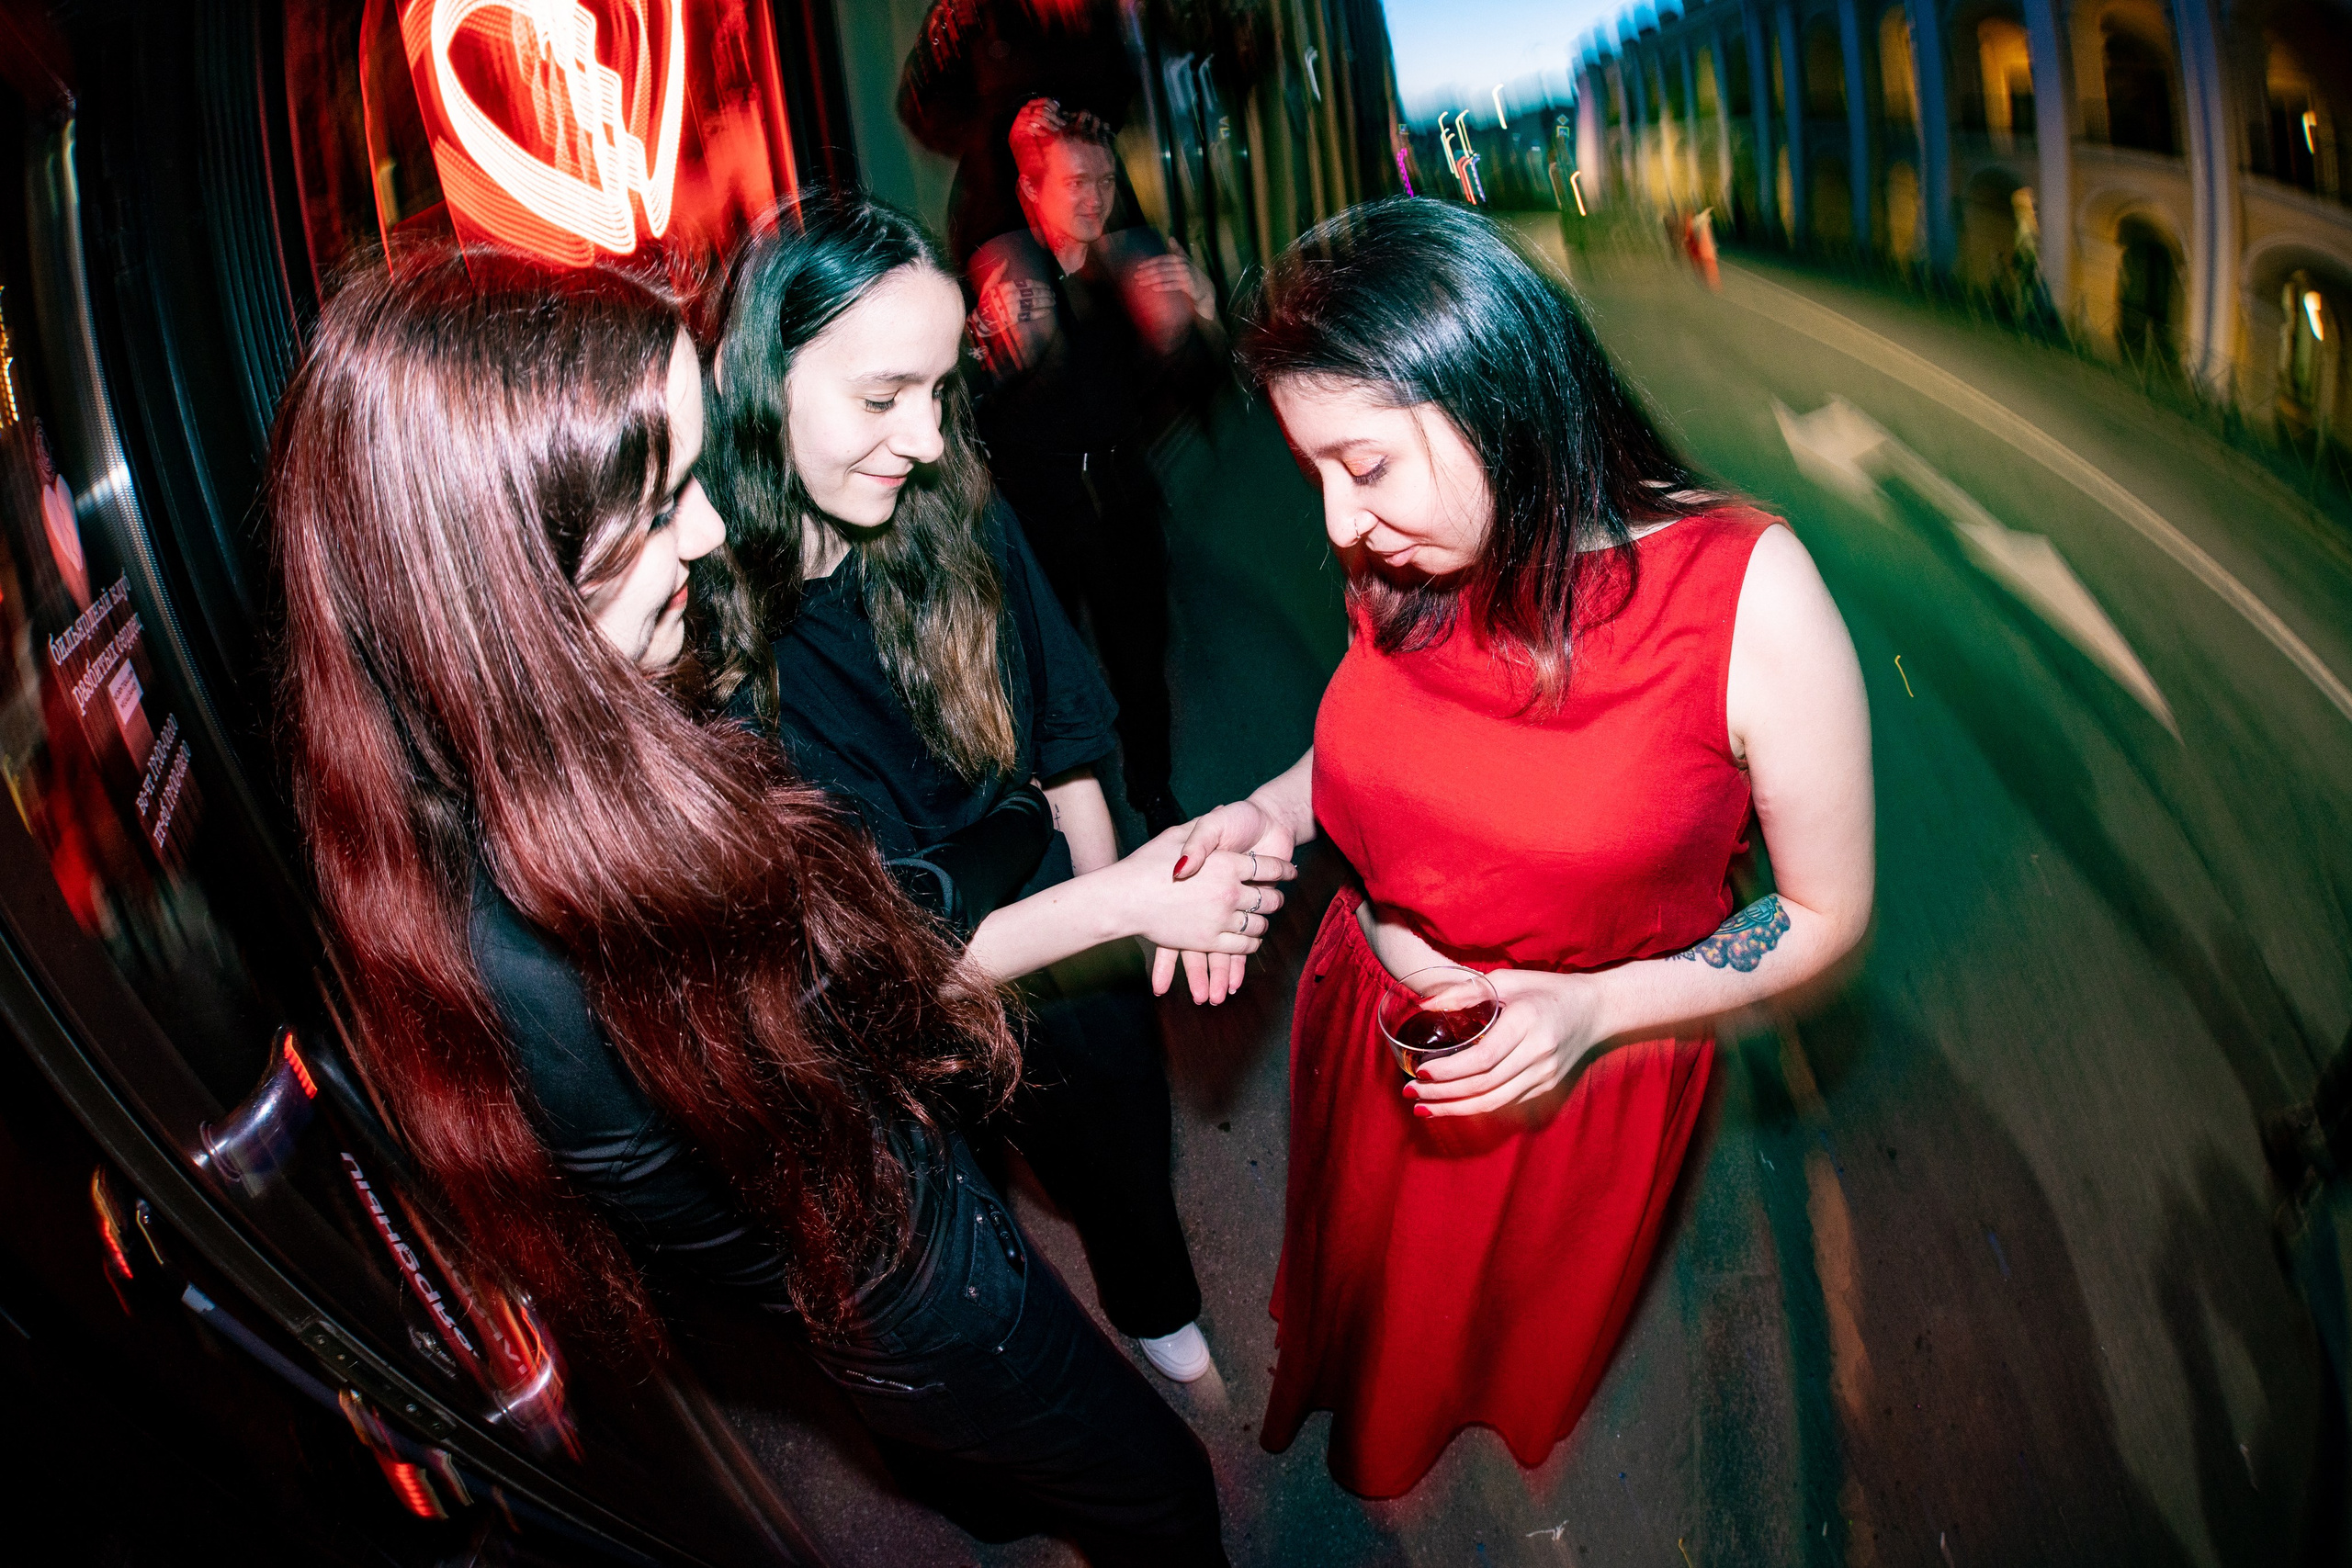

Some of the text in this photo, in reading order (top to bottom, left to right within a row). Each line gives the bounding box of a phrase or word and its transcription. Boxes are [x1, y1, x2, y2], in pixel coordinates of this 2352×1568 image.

[48, 567, 131, 666] бильярдный клуб
[73, 641, 120, 716] разбитых
[114, 612, 145, 653] сердец
